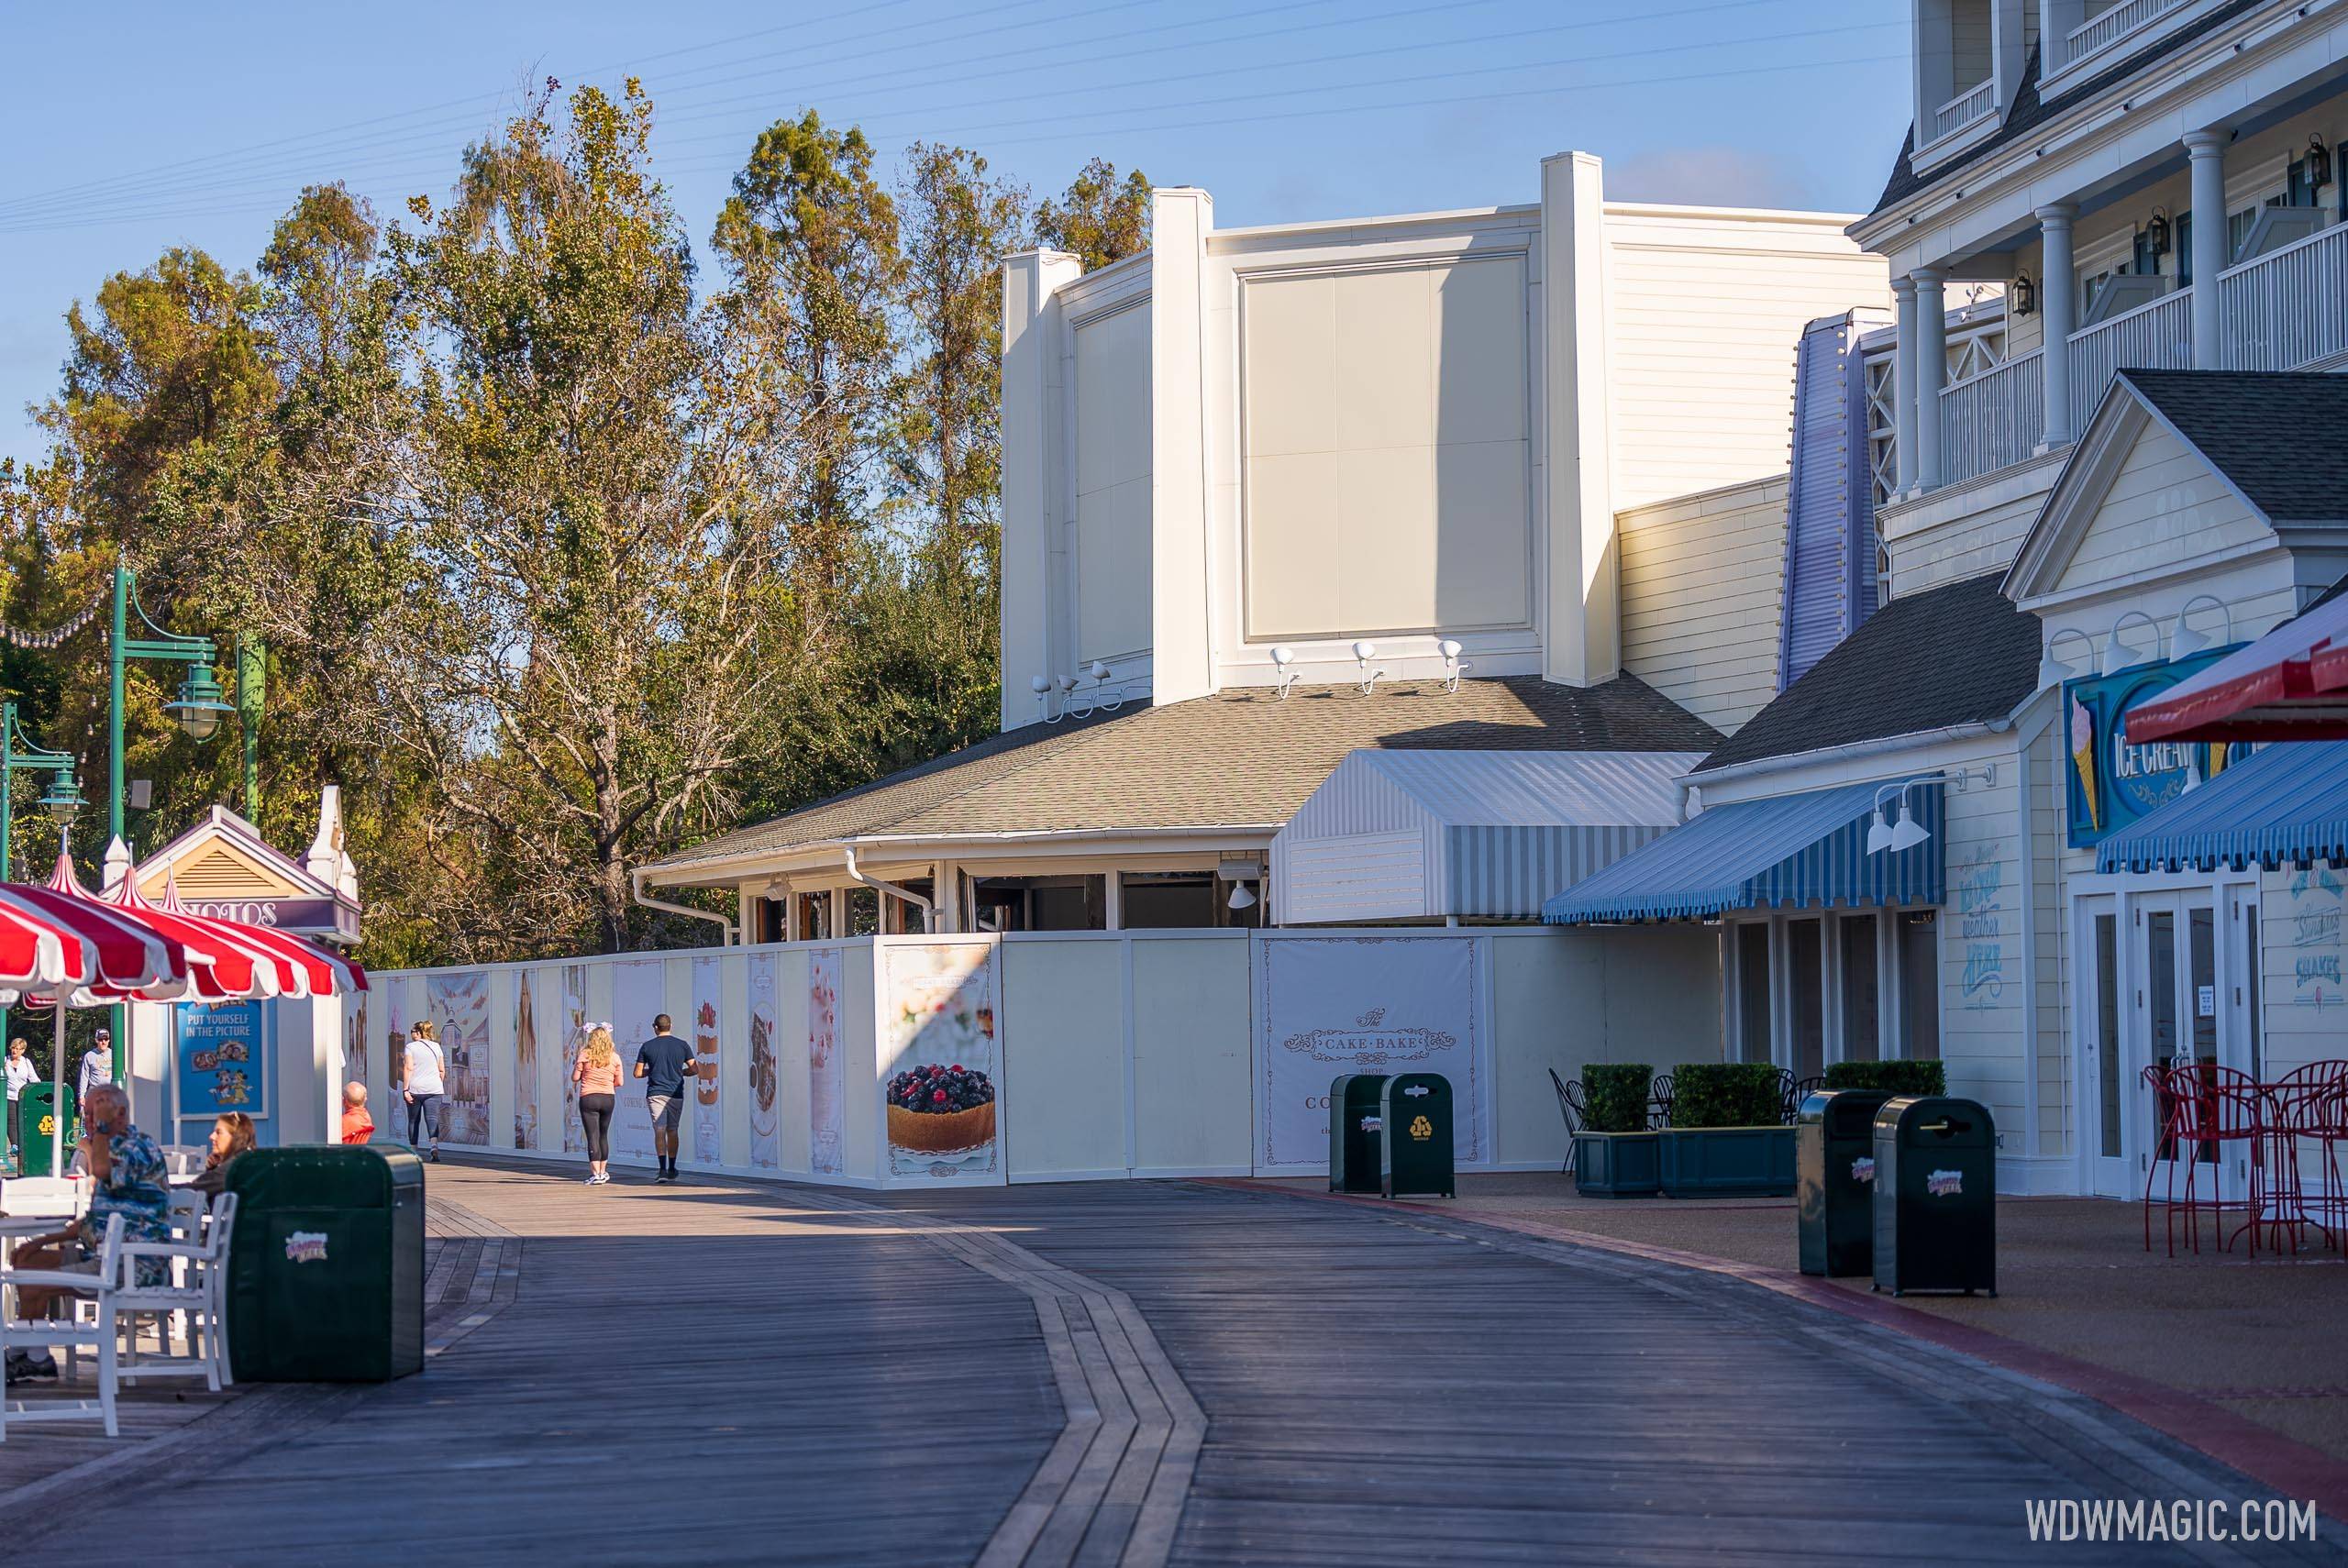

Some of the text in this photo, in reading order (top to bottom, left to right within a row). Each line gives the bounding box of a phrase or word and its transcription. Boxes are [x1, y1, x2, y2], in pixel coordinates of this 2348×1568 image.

[2114, 733, 2139, 778] ICE
[183, 902, 278, 926] OTOS
[2296, 954, 2342, 988] SHAKES
[187, 1013, 249, 1025] PUT YOURSELF
[1357, 1008, 1386, 1027] The
[186, 1025, 250, 1037] IN THE PICTURE
[1325, 1038, 1418, 1050] CAKE BAKE
